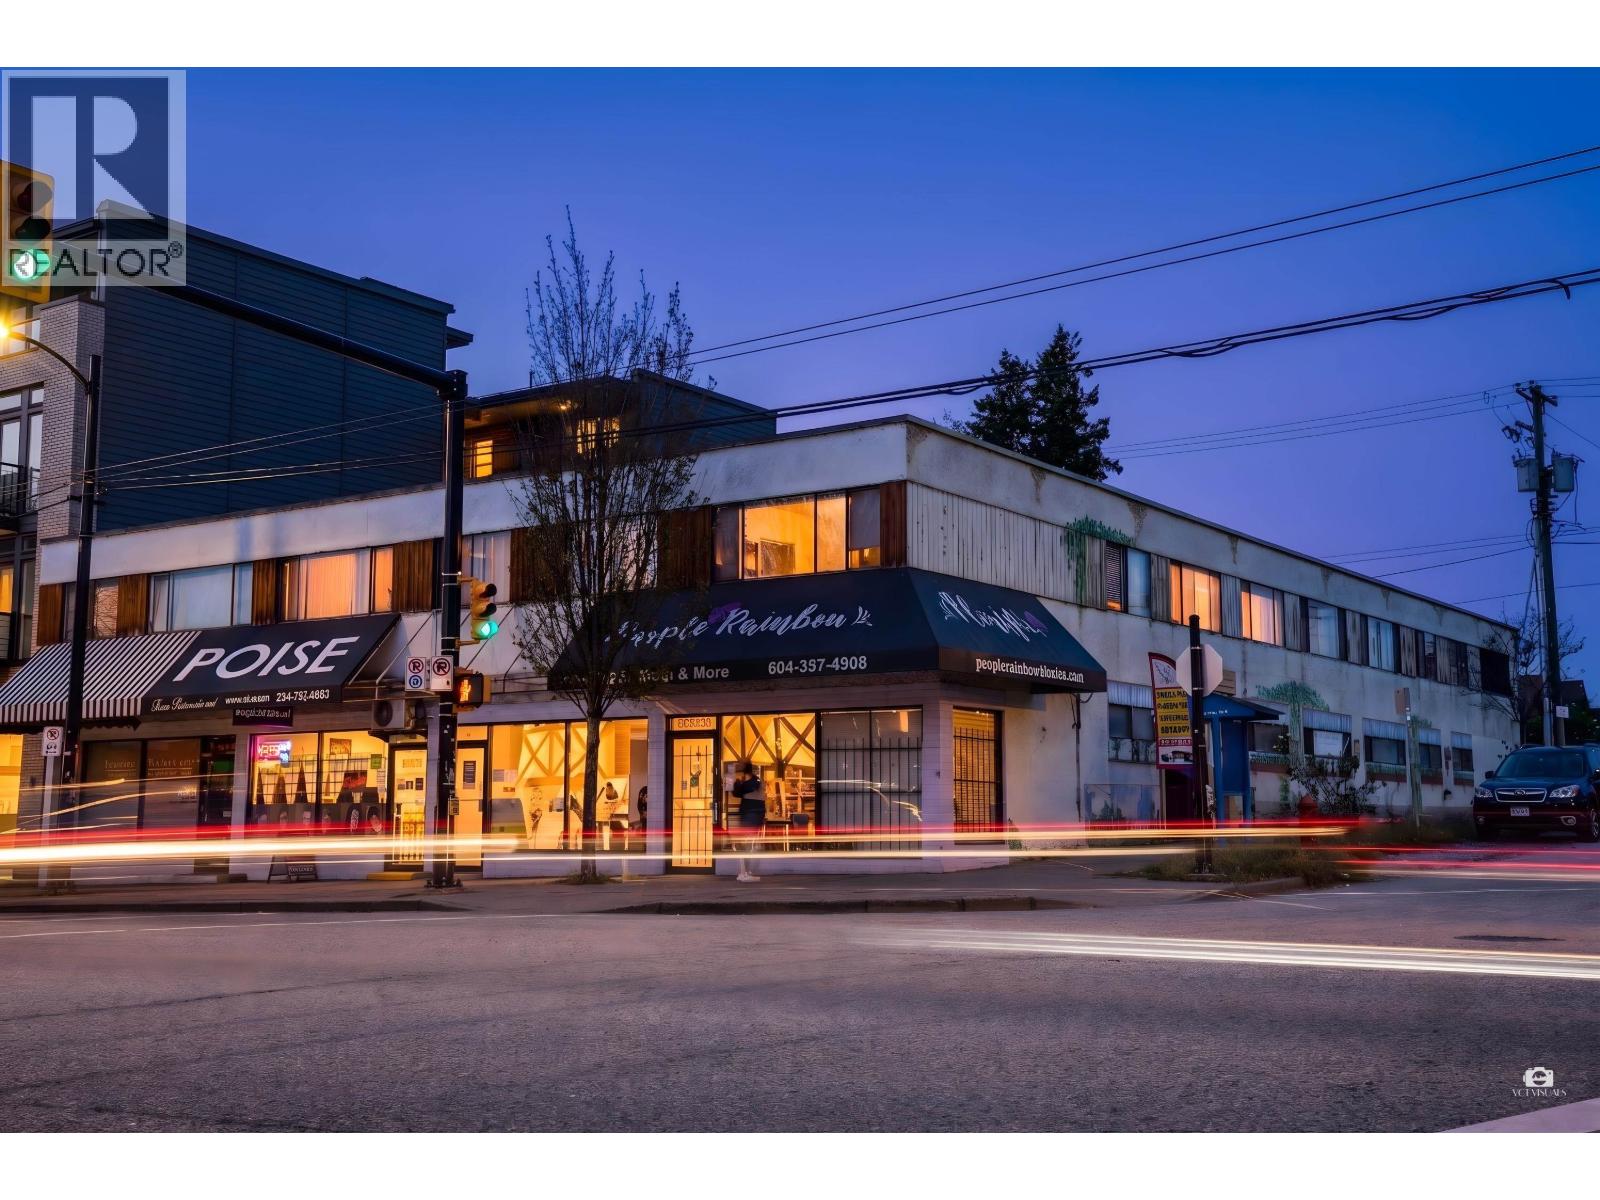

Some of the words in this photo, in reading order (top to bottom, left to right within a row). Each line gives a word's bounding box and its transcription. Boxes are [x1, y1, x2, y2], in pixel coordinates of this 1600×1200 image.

[172, 636, 360, 682] POISE
[678, 667, 689, 681] &
[694, 666, 730, 680] More
